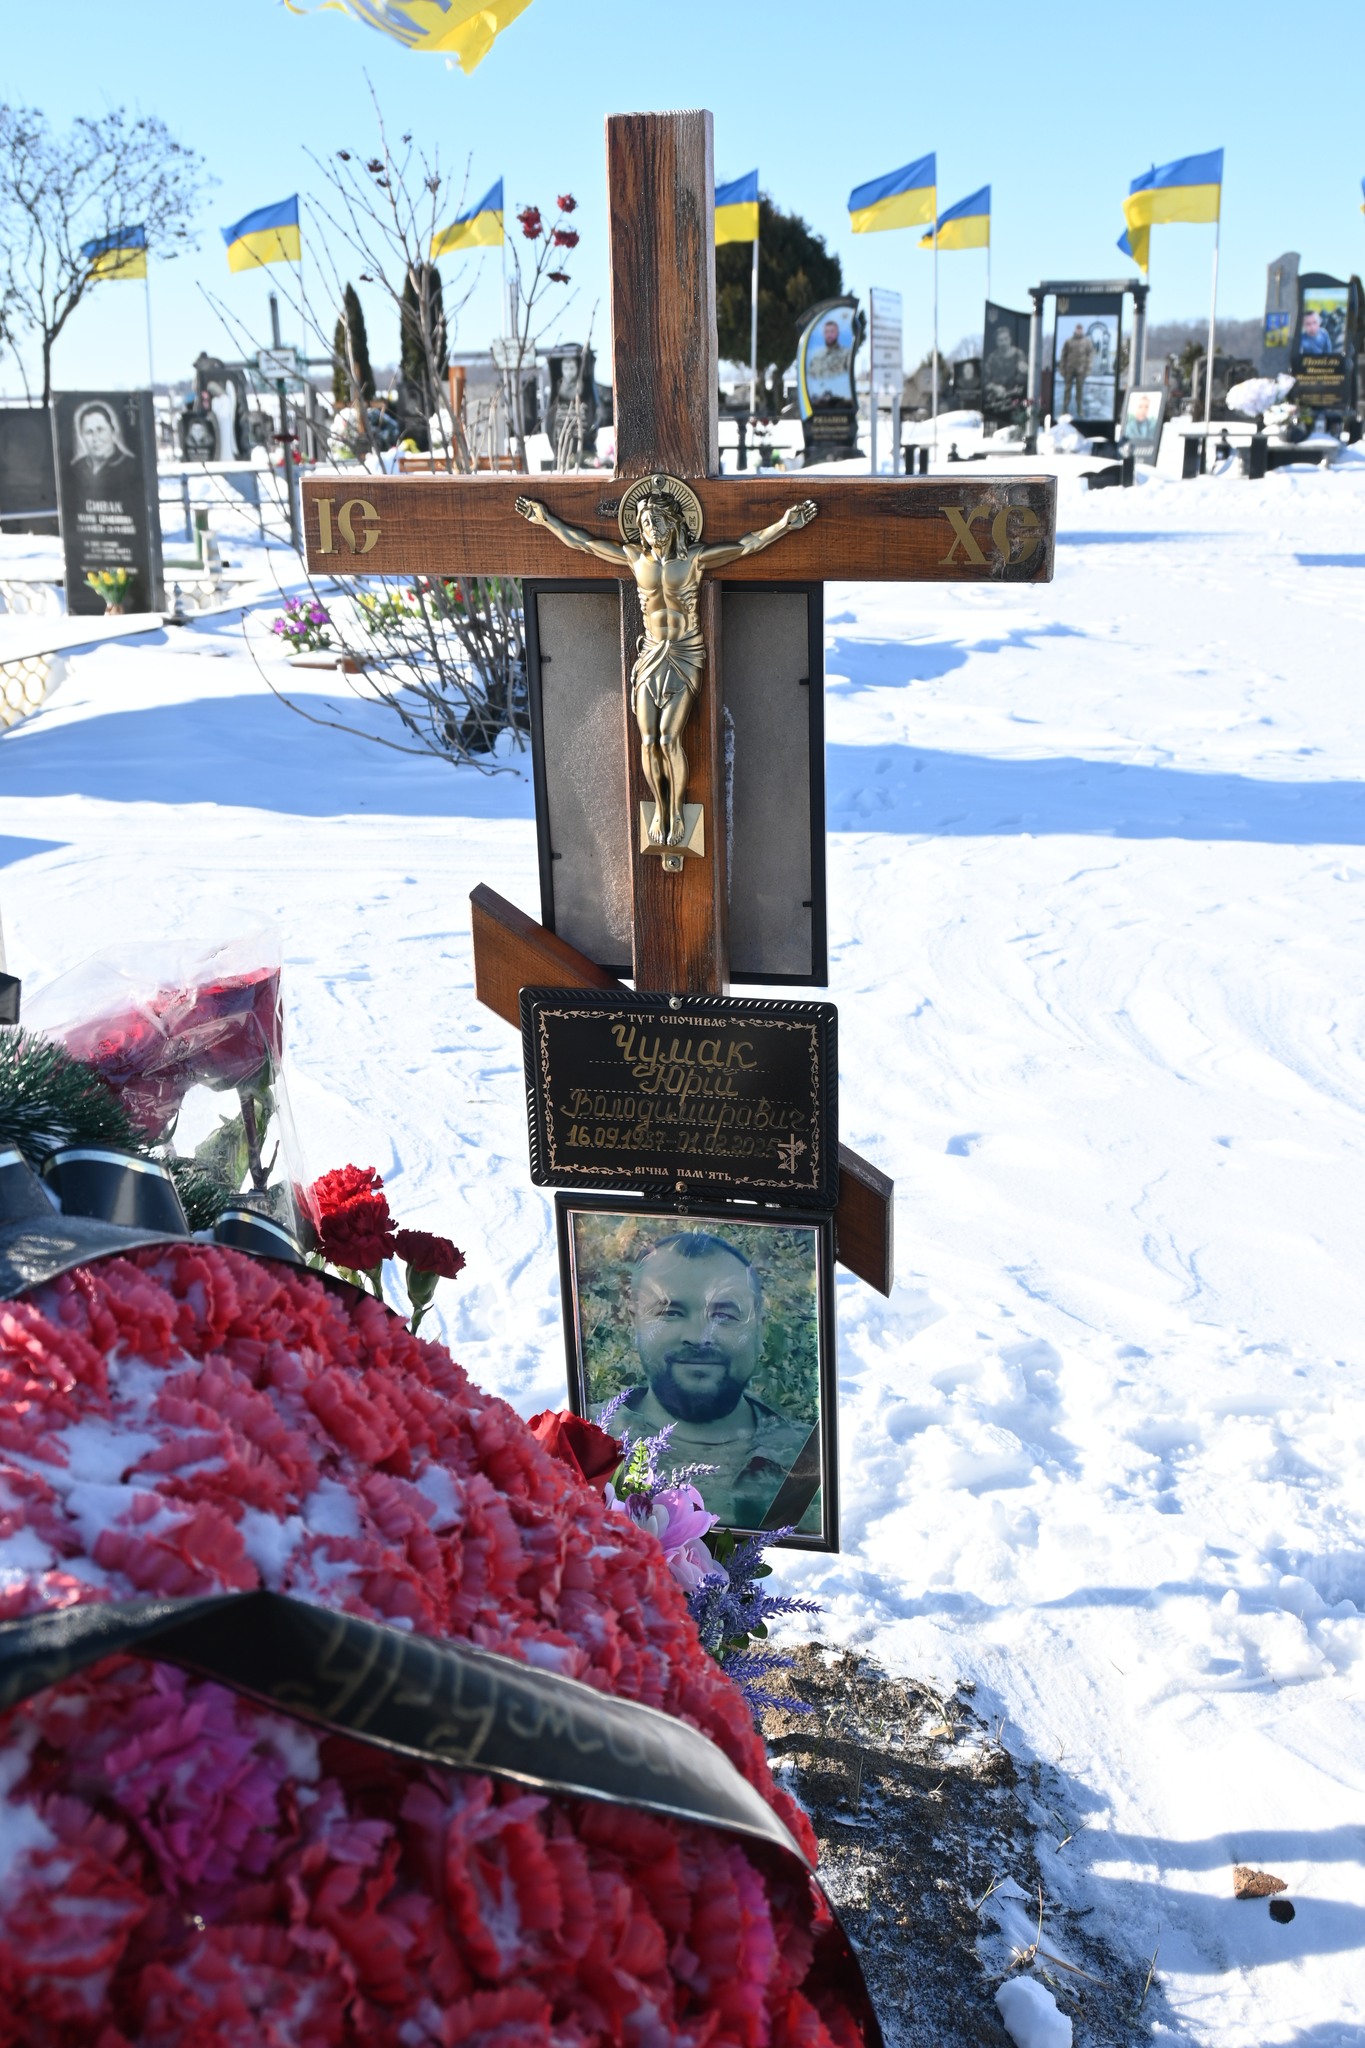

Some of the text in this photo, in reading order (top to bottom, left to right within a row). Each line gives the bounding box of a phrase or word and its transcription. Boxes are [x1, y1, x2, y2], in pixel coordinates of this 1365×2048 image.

[626, 1013, 728, 1028] ТУТ СПОЧИВАЄ
[610, 1023, 758, 1070] Чумак
[631, 1063, 739, 1105] Юрій
[559, 1088, 809, 1138] Володимирович
[634, 1166, 732, 1181] ВІЧНА ПАМ'ЯТЬ
